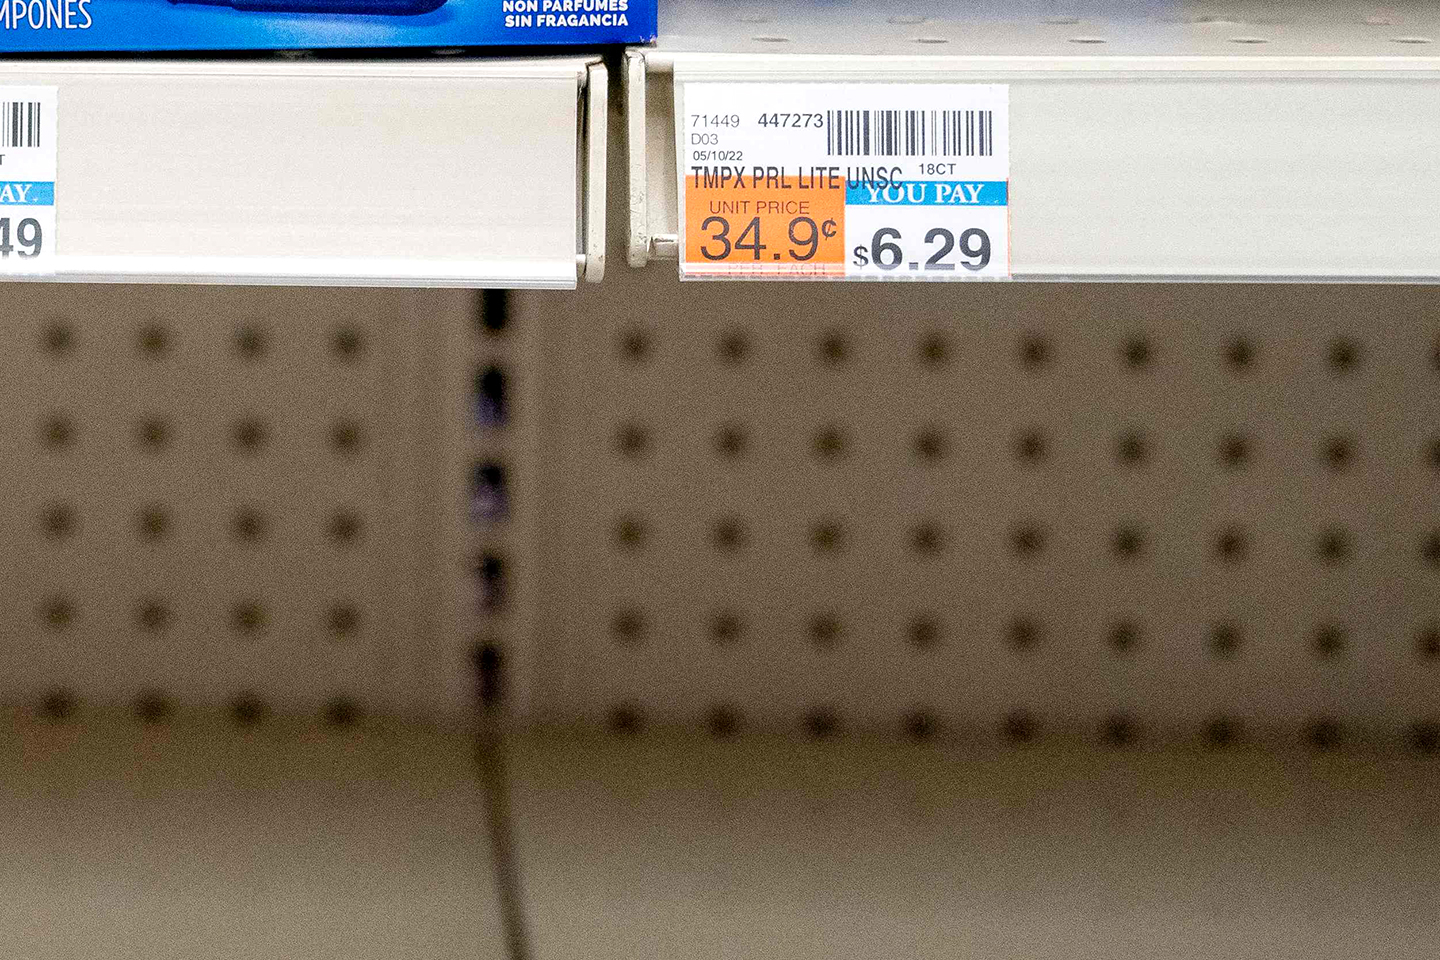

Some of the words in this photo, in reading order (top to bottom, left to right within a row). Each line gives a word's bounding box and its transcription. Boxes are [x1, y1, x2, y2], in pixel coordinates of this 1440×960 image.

[502, 0, 538, 13] NON
[504, 14, 533, 28] SIN
[536, 12, 628, 27] FRAGANCIA
[691, 114, 740, 128] 71449
[758, 113, 824, 128] 447273
[691, 133, 719, 146] D03
[693, 150, 743, 162] 05/10/22
[919, 163, 956, 175] 18CT
[691, 166, 746, 189] TMPX
[753, 166, 792, 189] PRL
[799, 167, 840, 189] LITE
[847, 167, 903, 190] UNSC
[866, 183, 927, 204] YOU
[935, 183, 984, 204] PAY
[710, 201, 749, 214] UNIT
[756, 201, 810, 215] PRICE
[853, 228, 991, 271] $6.29
